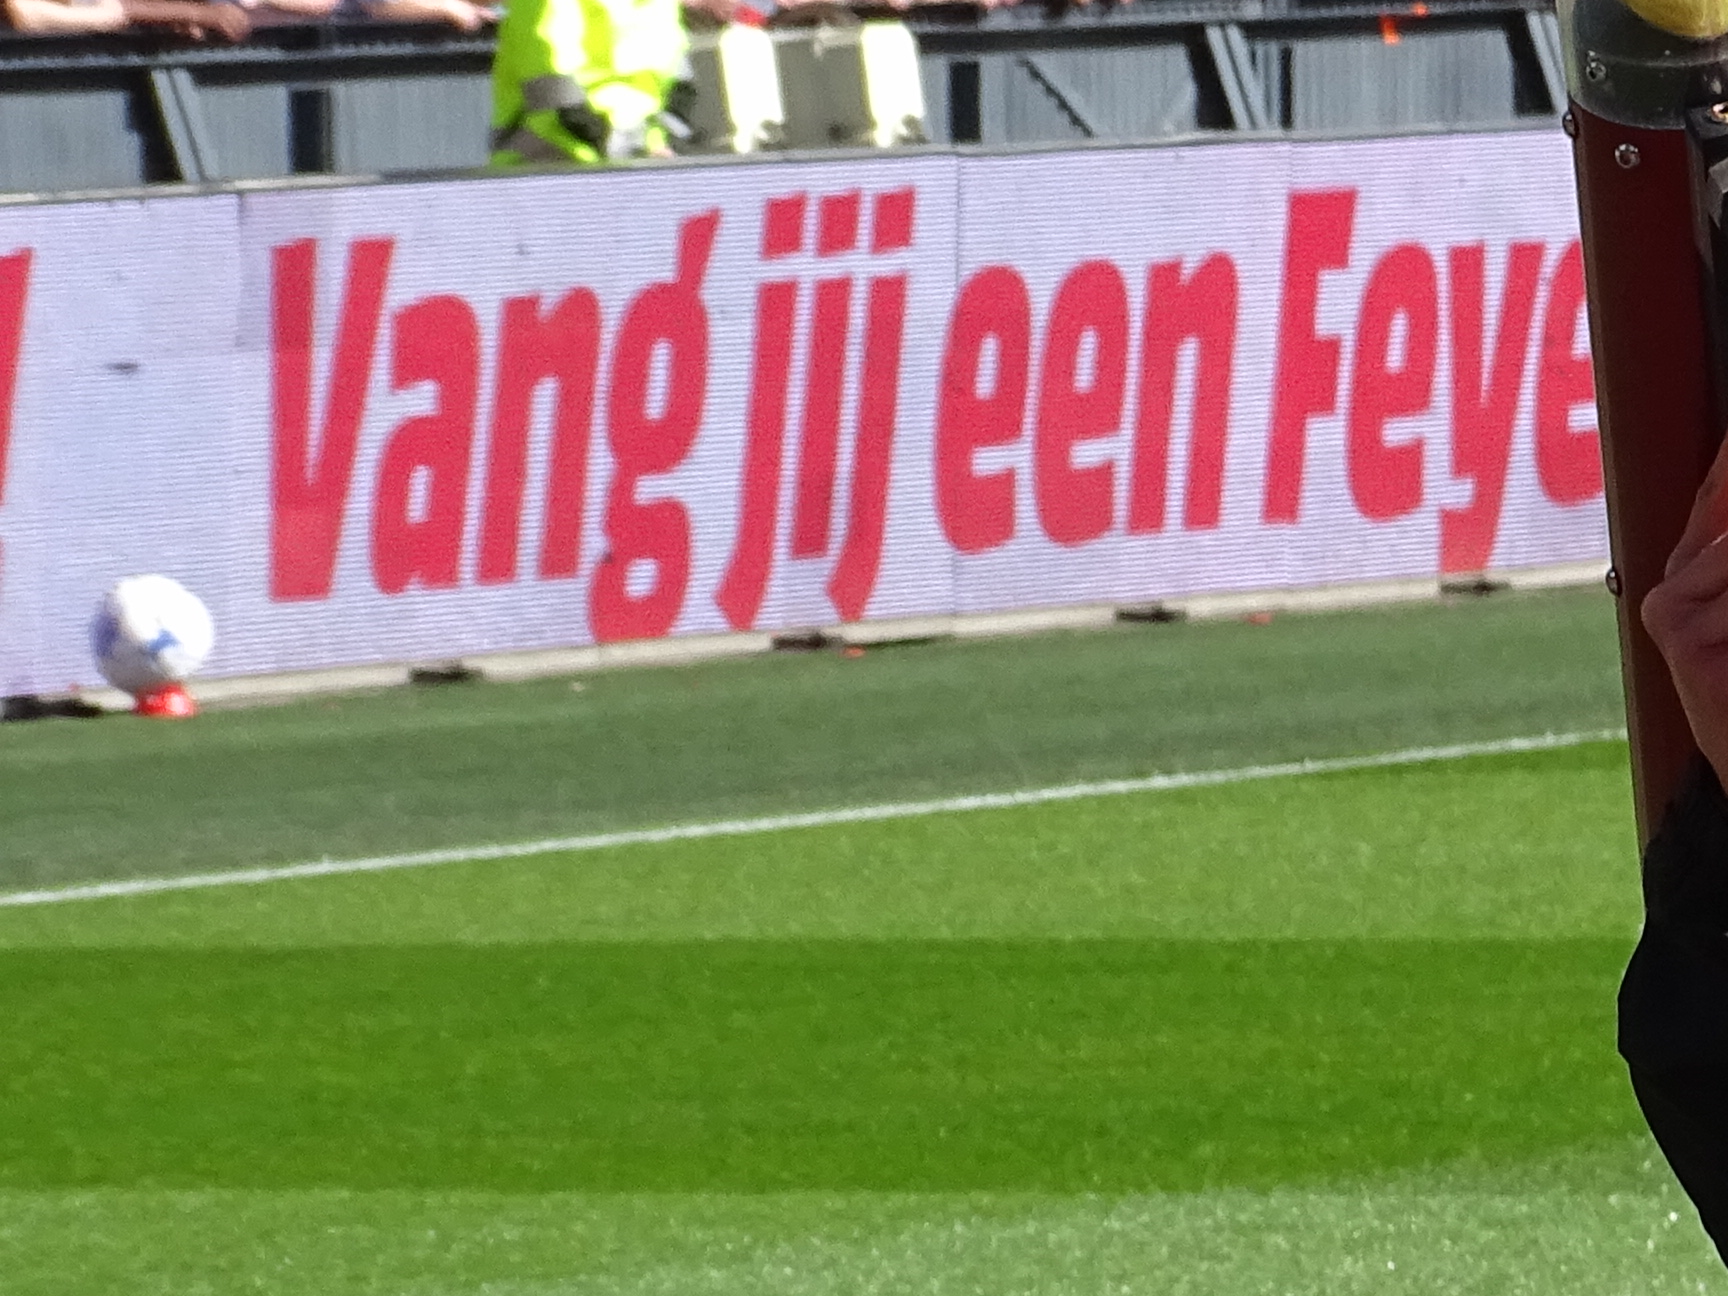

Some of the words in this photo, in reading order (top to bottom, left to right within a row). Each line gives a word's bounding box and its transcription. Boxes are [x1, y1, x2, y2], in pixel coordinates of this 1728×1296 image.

[271, 209, 720, 643] Vang
[716, 188, 915, 630] jij
[936, 252, 1239, 554] een
